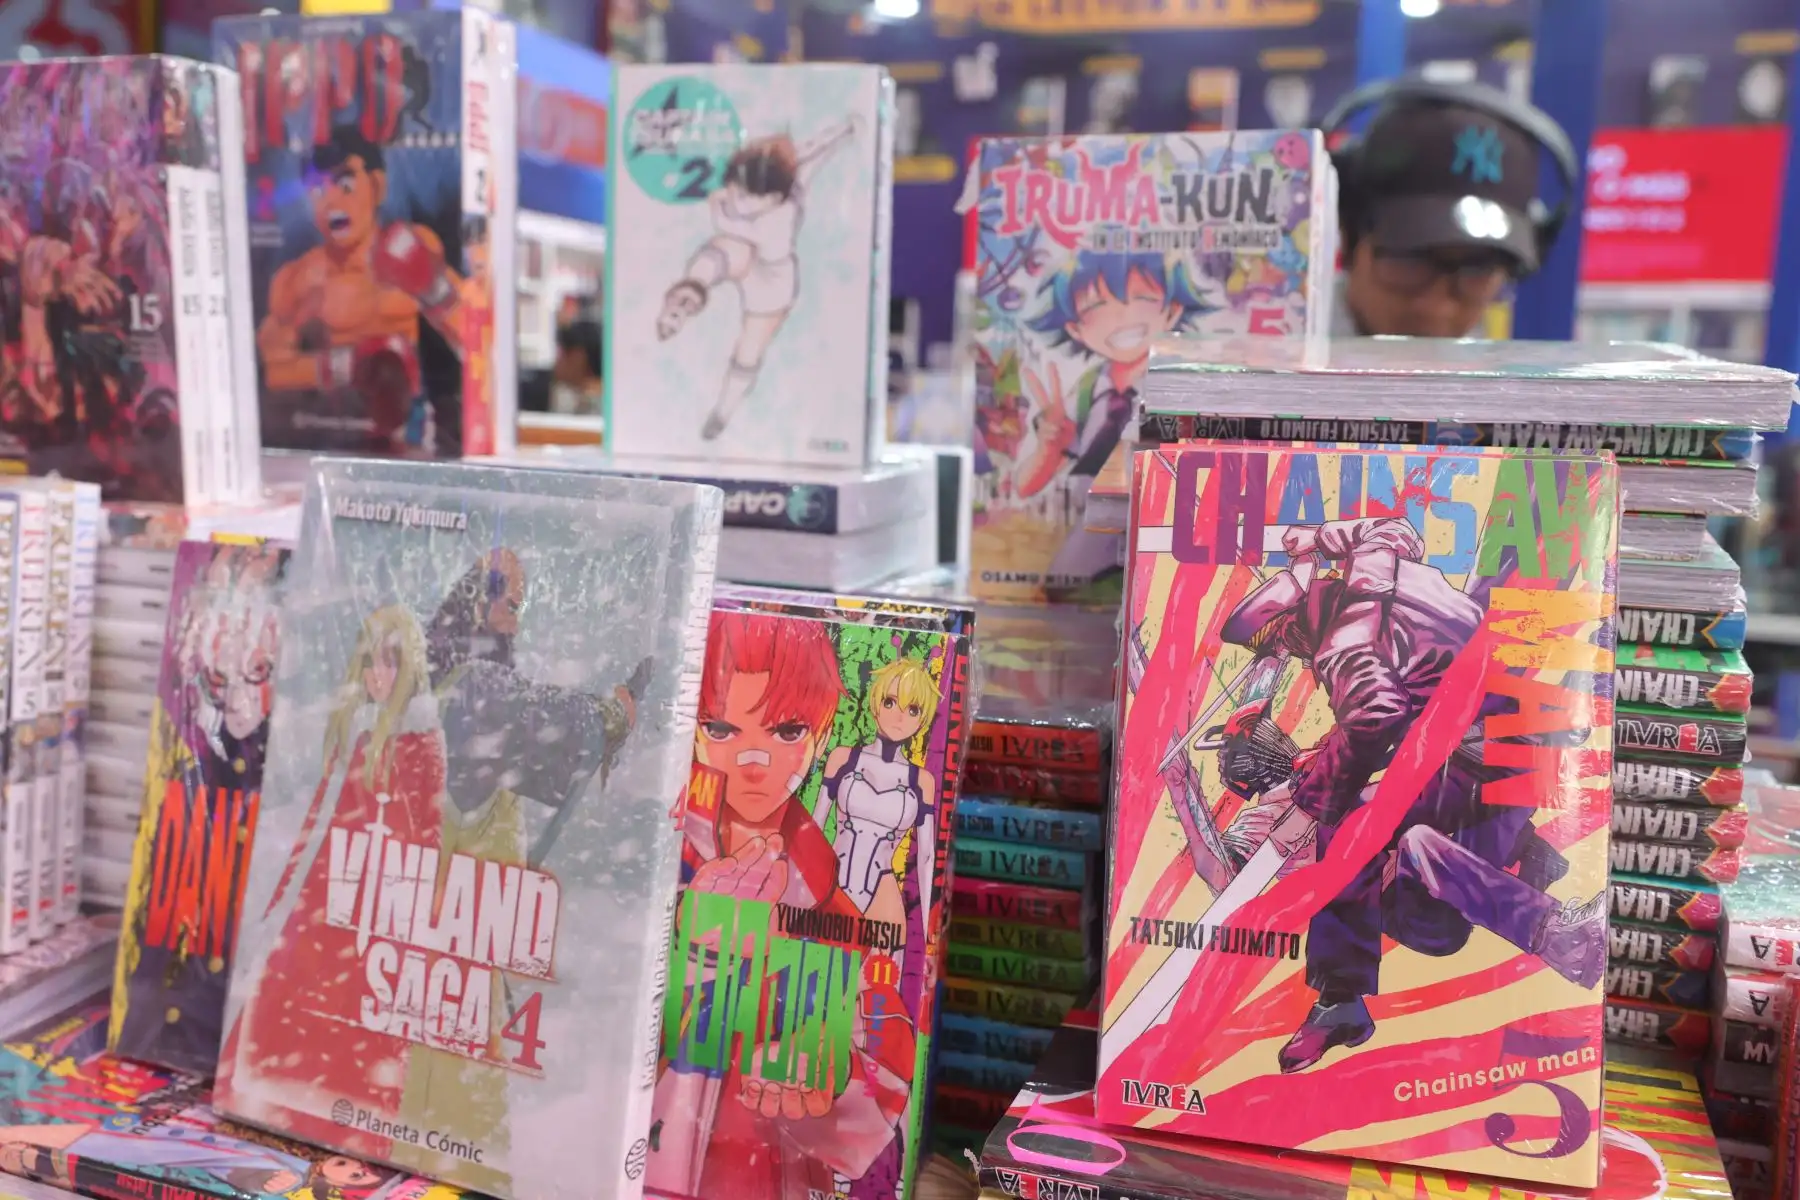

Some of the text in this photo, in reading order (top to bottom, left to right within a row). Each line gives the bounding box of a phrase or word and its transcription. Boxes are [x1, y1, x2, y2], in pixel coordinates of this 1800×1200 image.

[674, 156, 714, 198] 2
[994, 142, 1275, 248] IRUMA-KUN
[129, 294, 162, 332] 15
[1248, 308, 1285, 335] 5
[1261, 416, 1409, 442] TATSUKI FUJIMOTO
[1171, 448, 1616, 581] CHAINSAW
[981, 570, 1039, 584] OSAMU
[1481, 588, 1616, 808] MAN
[1618, 719, 1722, 756] IVREA
[1001, 815, 1083, 844] IVREA
[144, 780, 262, 966] DAN
[989, 850, 1070, 881] IVREA
[326, 800, 560, 980] VINLAND
[776, 902, 902, 951] YUKINOBU TATSU
[1130, 916, 1301, 961] TATSUKI FUJIMOTO
[872, 960, 892, 985] 11
[360, 941, 493, 1060] SAGA
[500, 991, 546, 1070] 4
[1744, 1040, 1778, 1065] MY
[1119, 1078, 1208, 1115] IVREA
[1393, 1045, 1596, 1103] Chainsaw man
[1484, 1028, 1591, 1160] 5
[355, 1107, 484, 1163] Planeta Cómic
